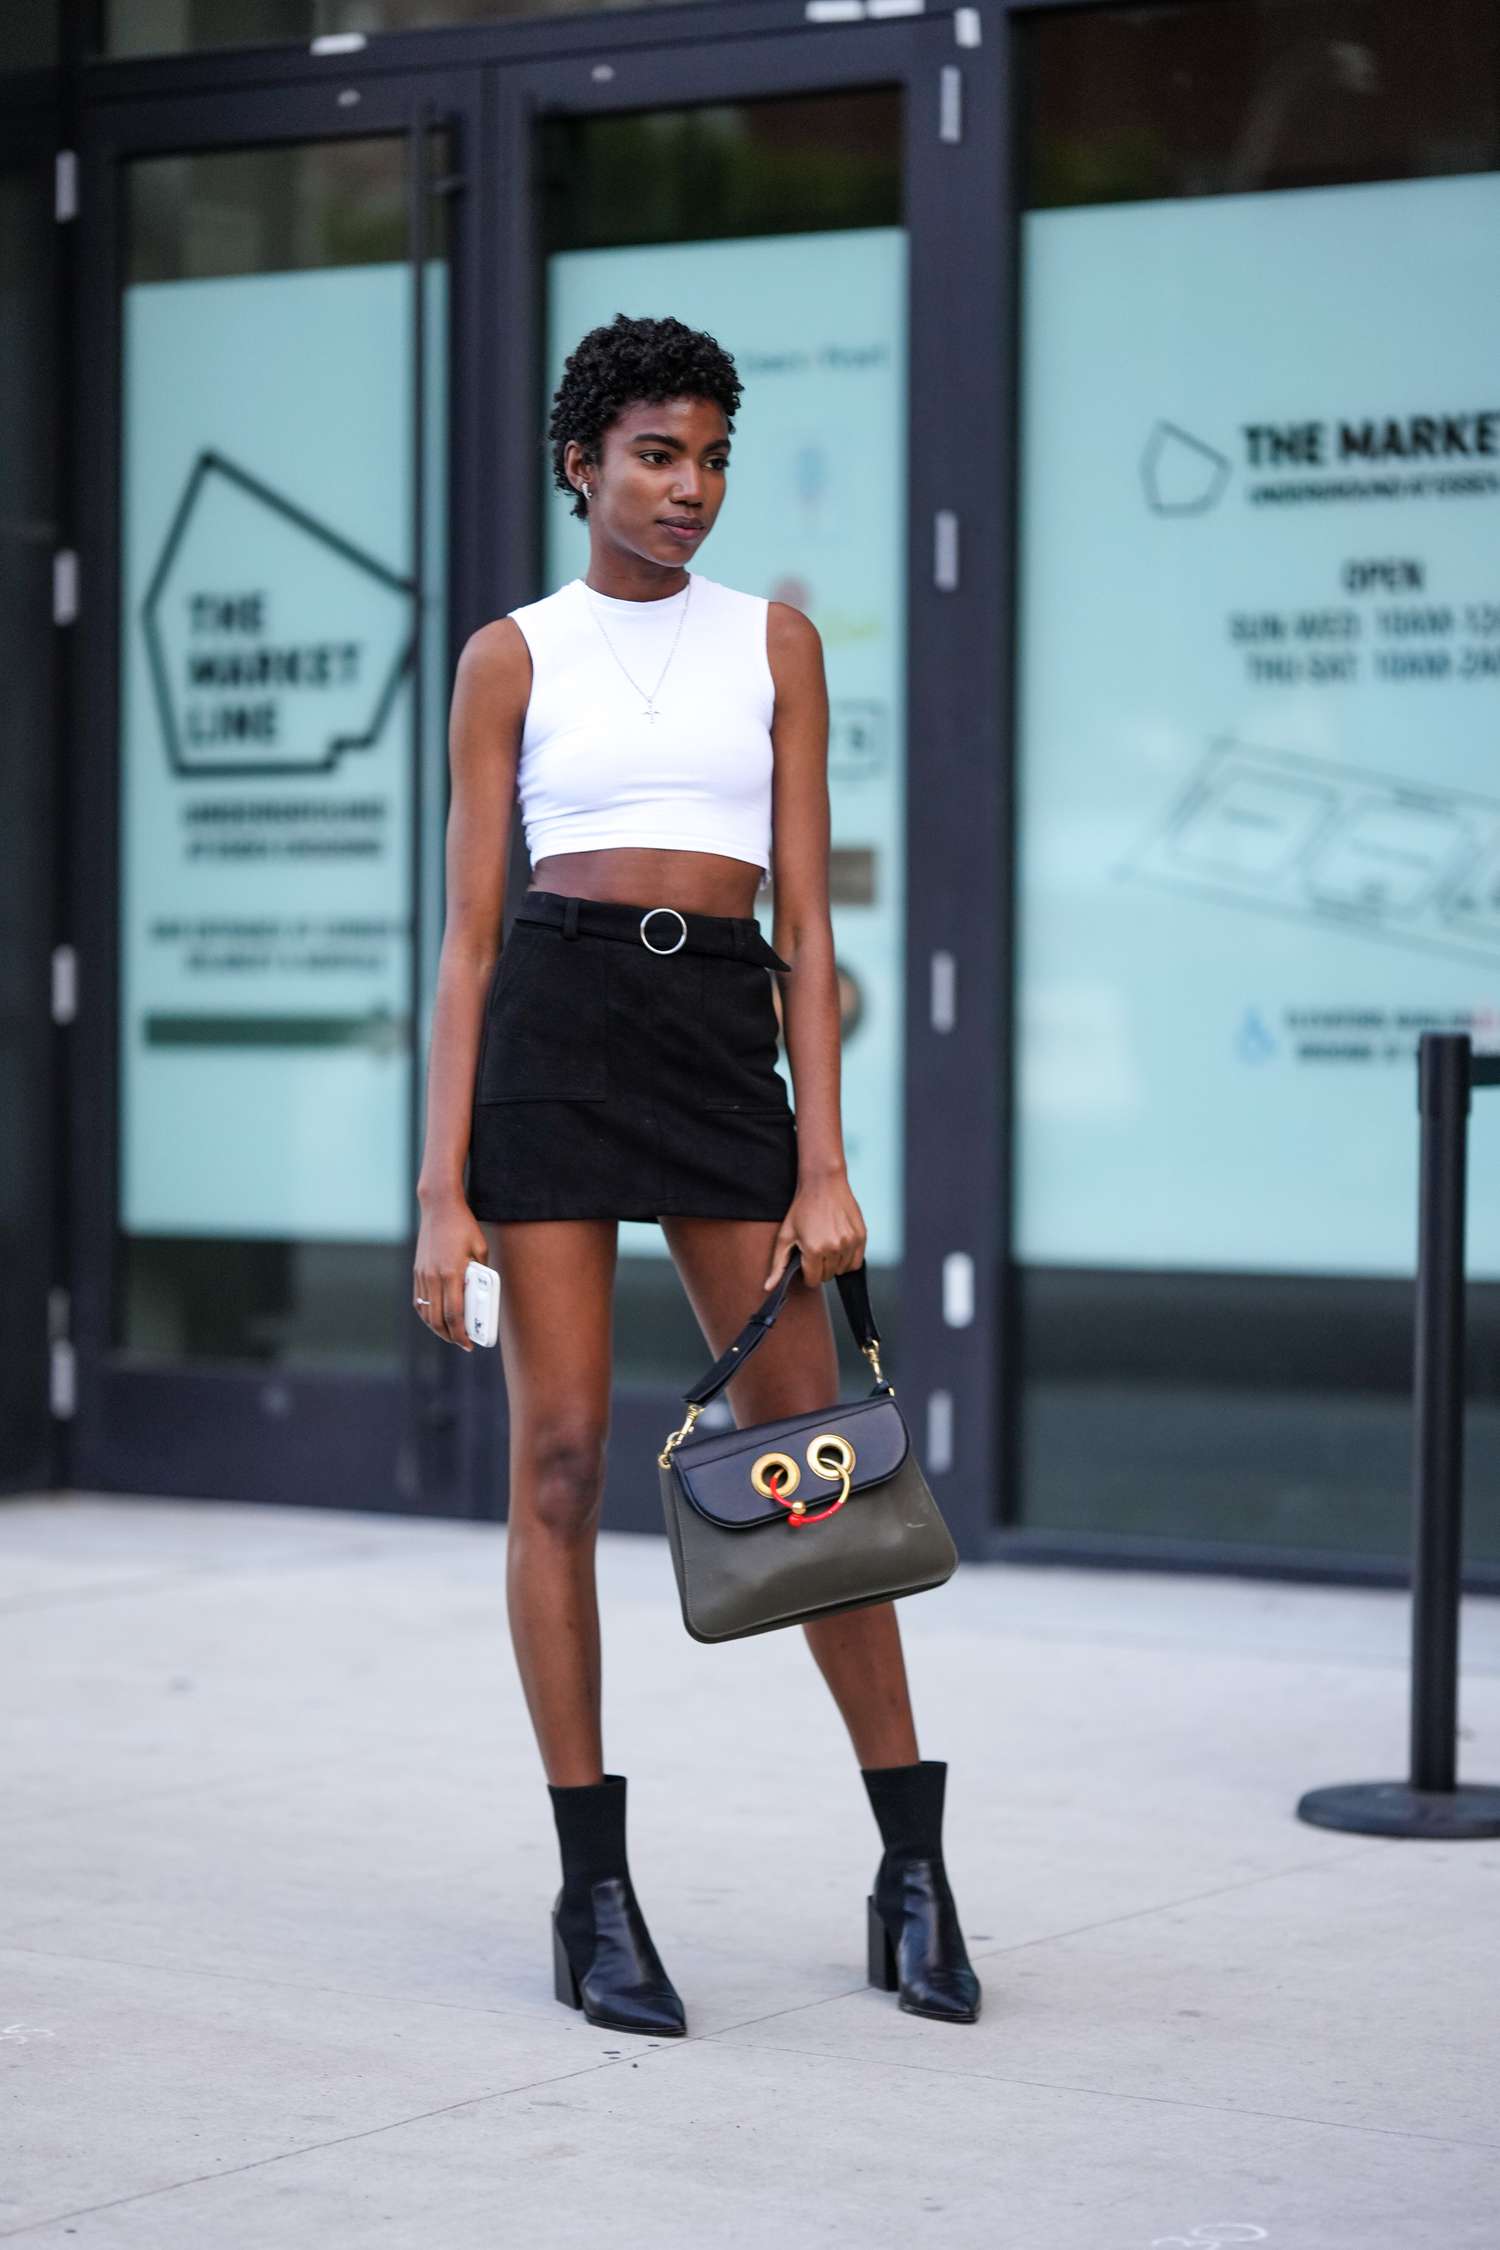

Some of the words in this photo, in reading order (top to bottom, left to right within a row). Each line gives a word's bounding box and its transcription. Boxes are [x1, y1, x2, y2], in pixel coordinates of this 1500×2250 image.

[1243, 421, 1324, 467] THE
[1344, 558, 1424, 592] OPEN
[190, 594, 263, 634] THE
[188, 644, 358, 687] MARKET
[186, 702, 277, 745] LINE
